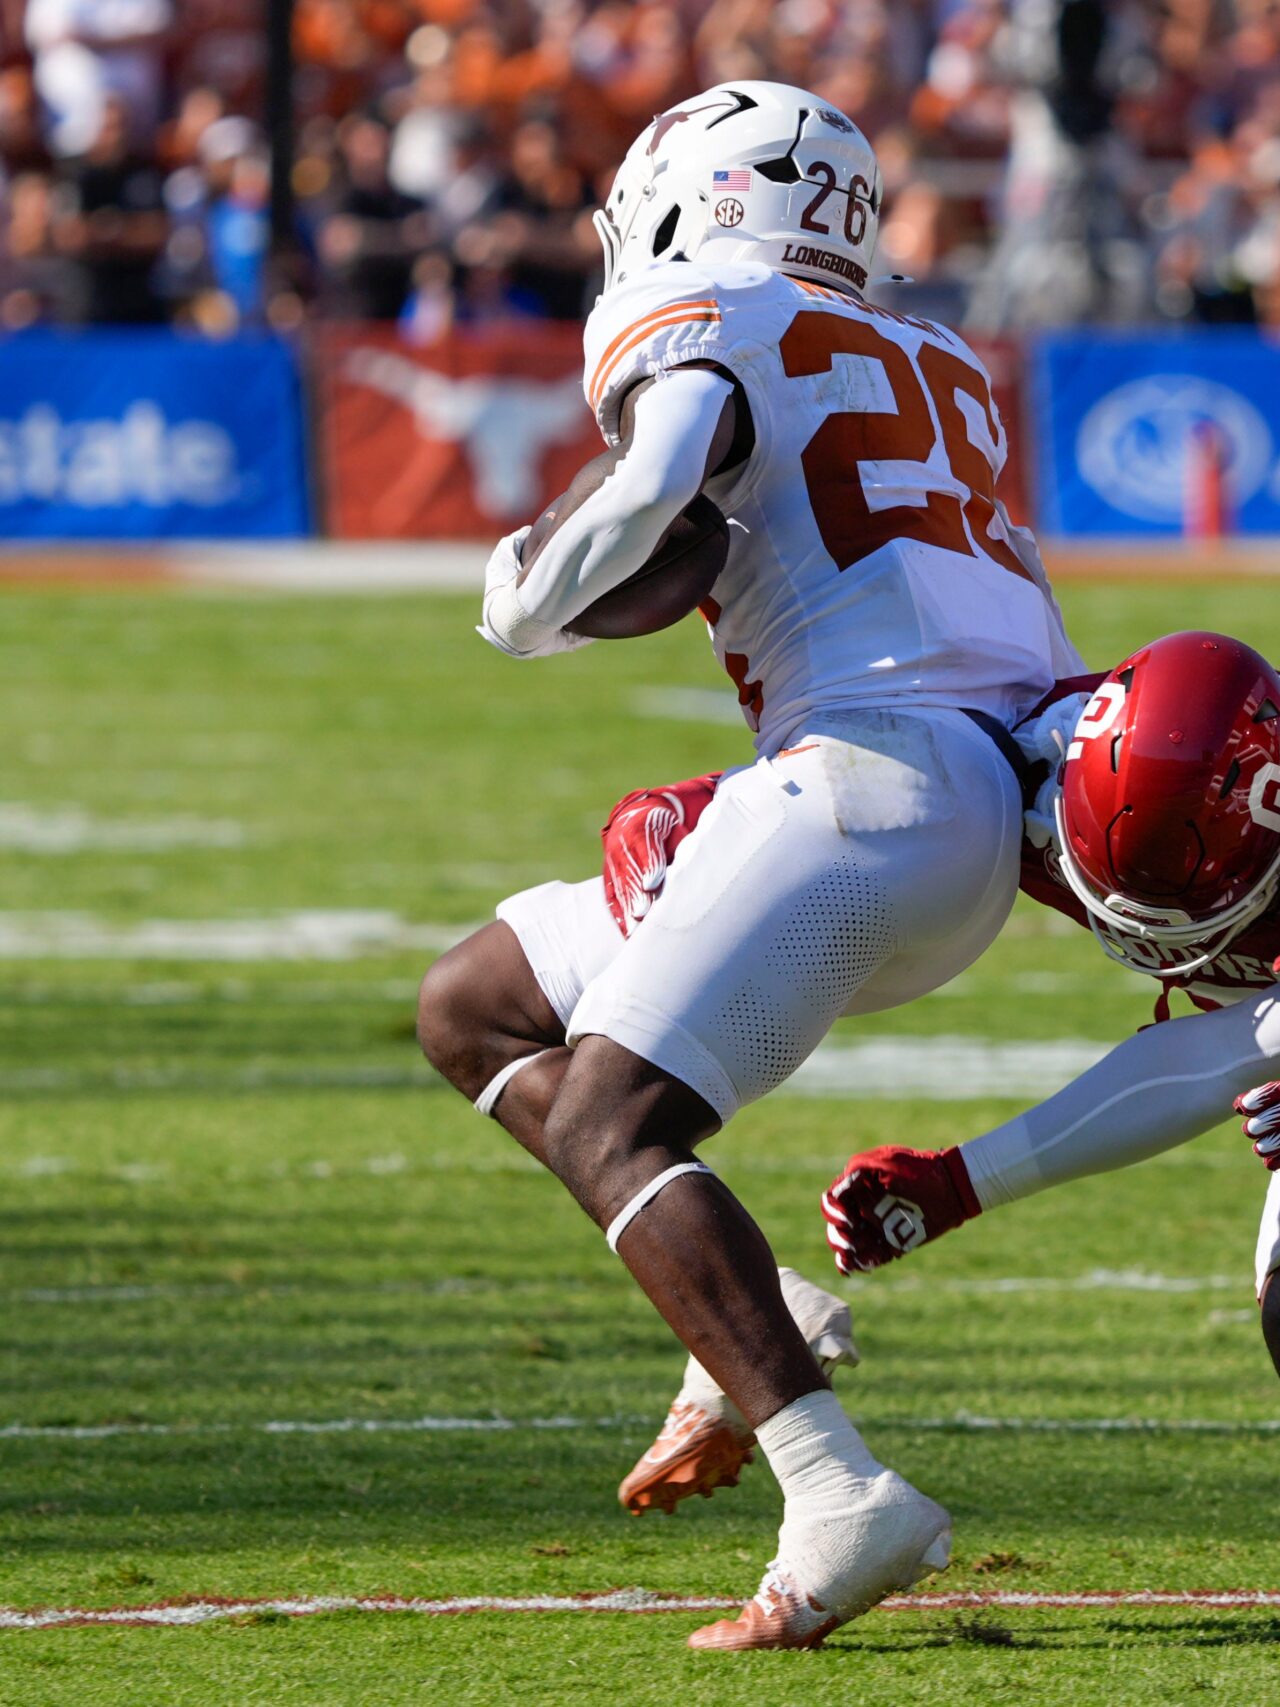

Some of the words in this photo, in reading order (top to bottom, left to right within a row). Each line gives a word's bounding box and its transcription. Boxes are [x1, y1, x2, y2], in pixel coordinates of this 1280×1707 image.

[715, 198, 744, 228] SEC
[801, 161, 869, 246] 26
[782, 244, 868, 290] LONGHORNS
